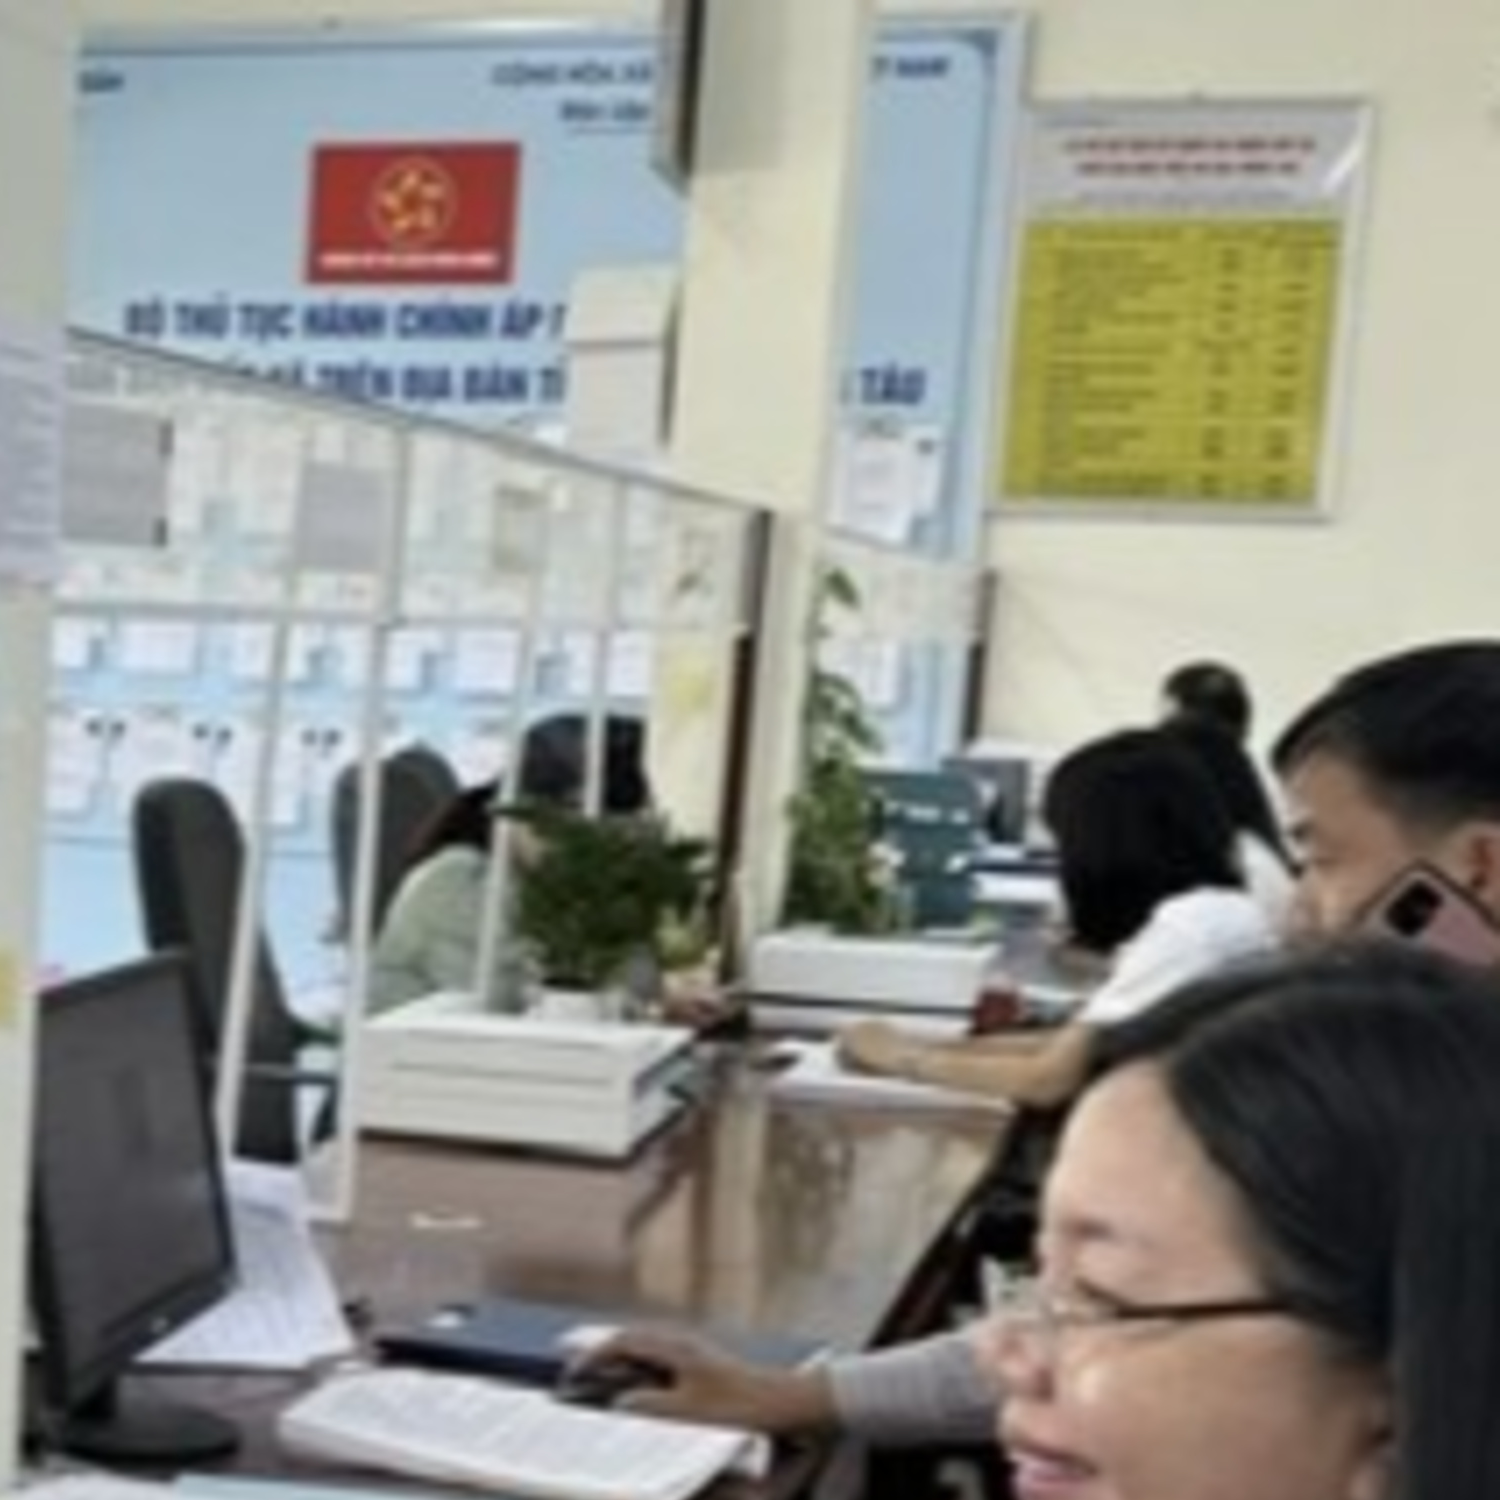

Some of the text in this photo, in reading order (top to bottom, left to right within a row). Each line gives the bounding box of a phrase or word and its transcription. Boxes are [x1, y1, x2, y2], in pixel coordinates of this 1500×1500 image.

[174, 290, 232, 339] THỦ
[239, 302, 294, 345] TỤC
[398, 295, 493, 338] CHÍNH
